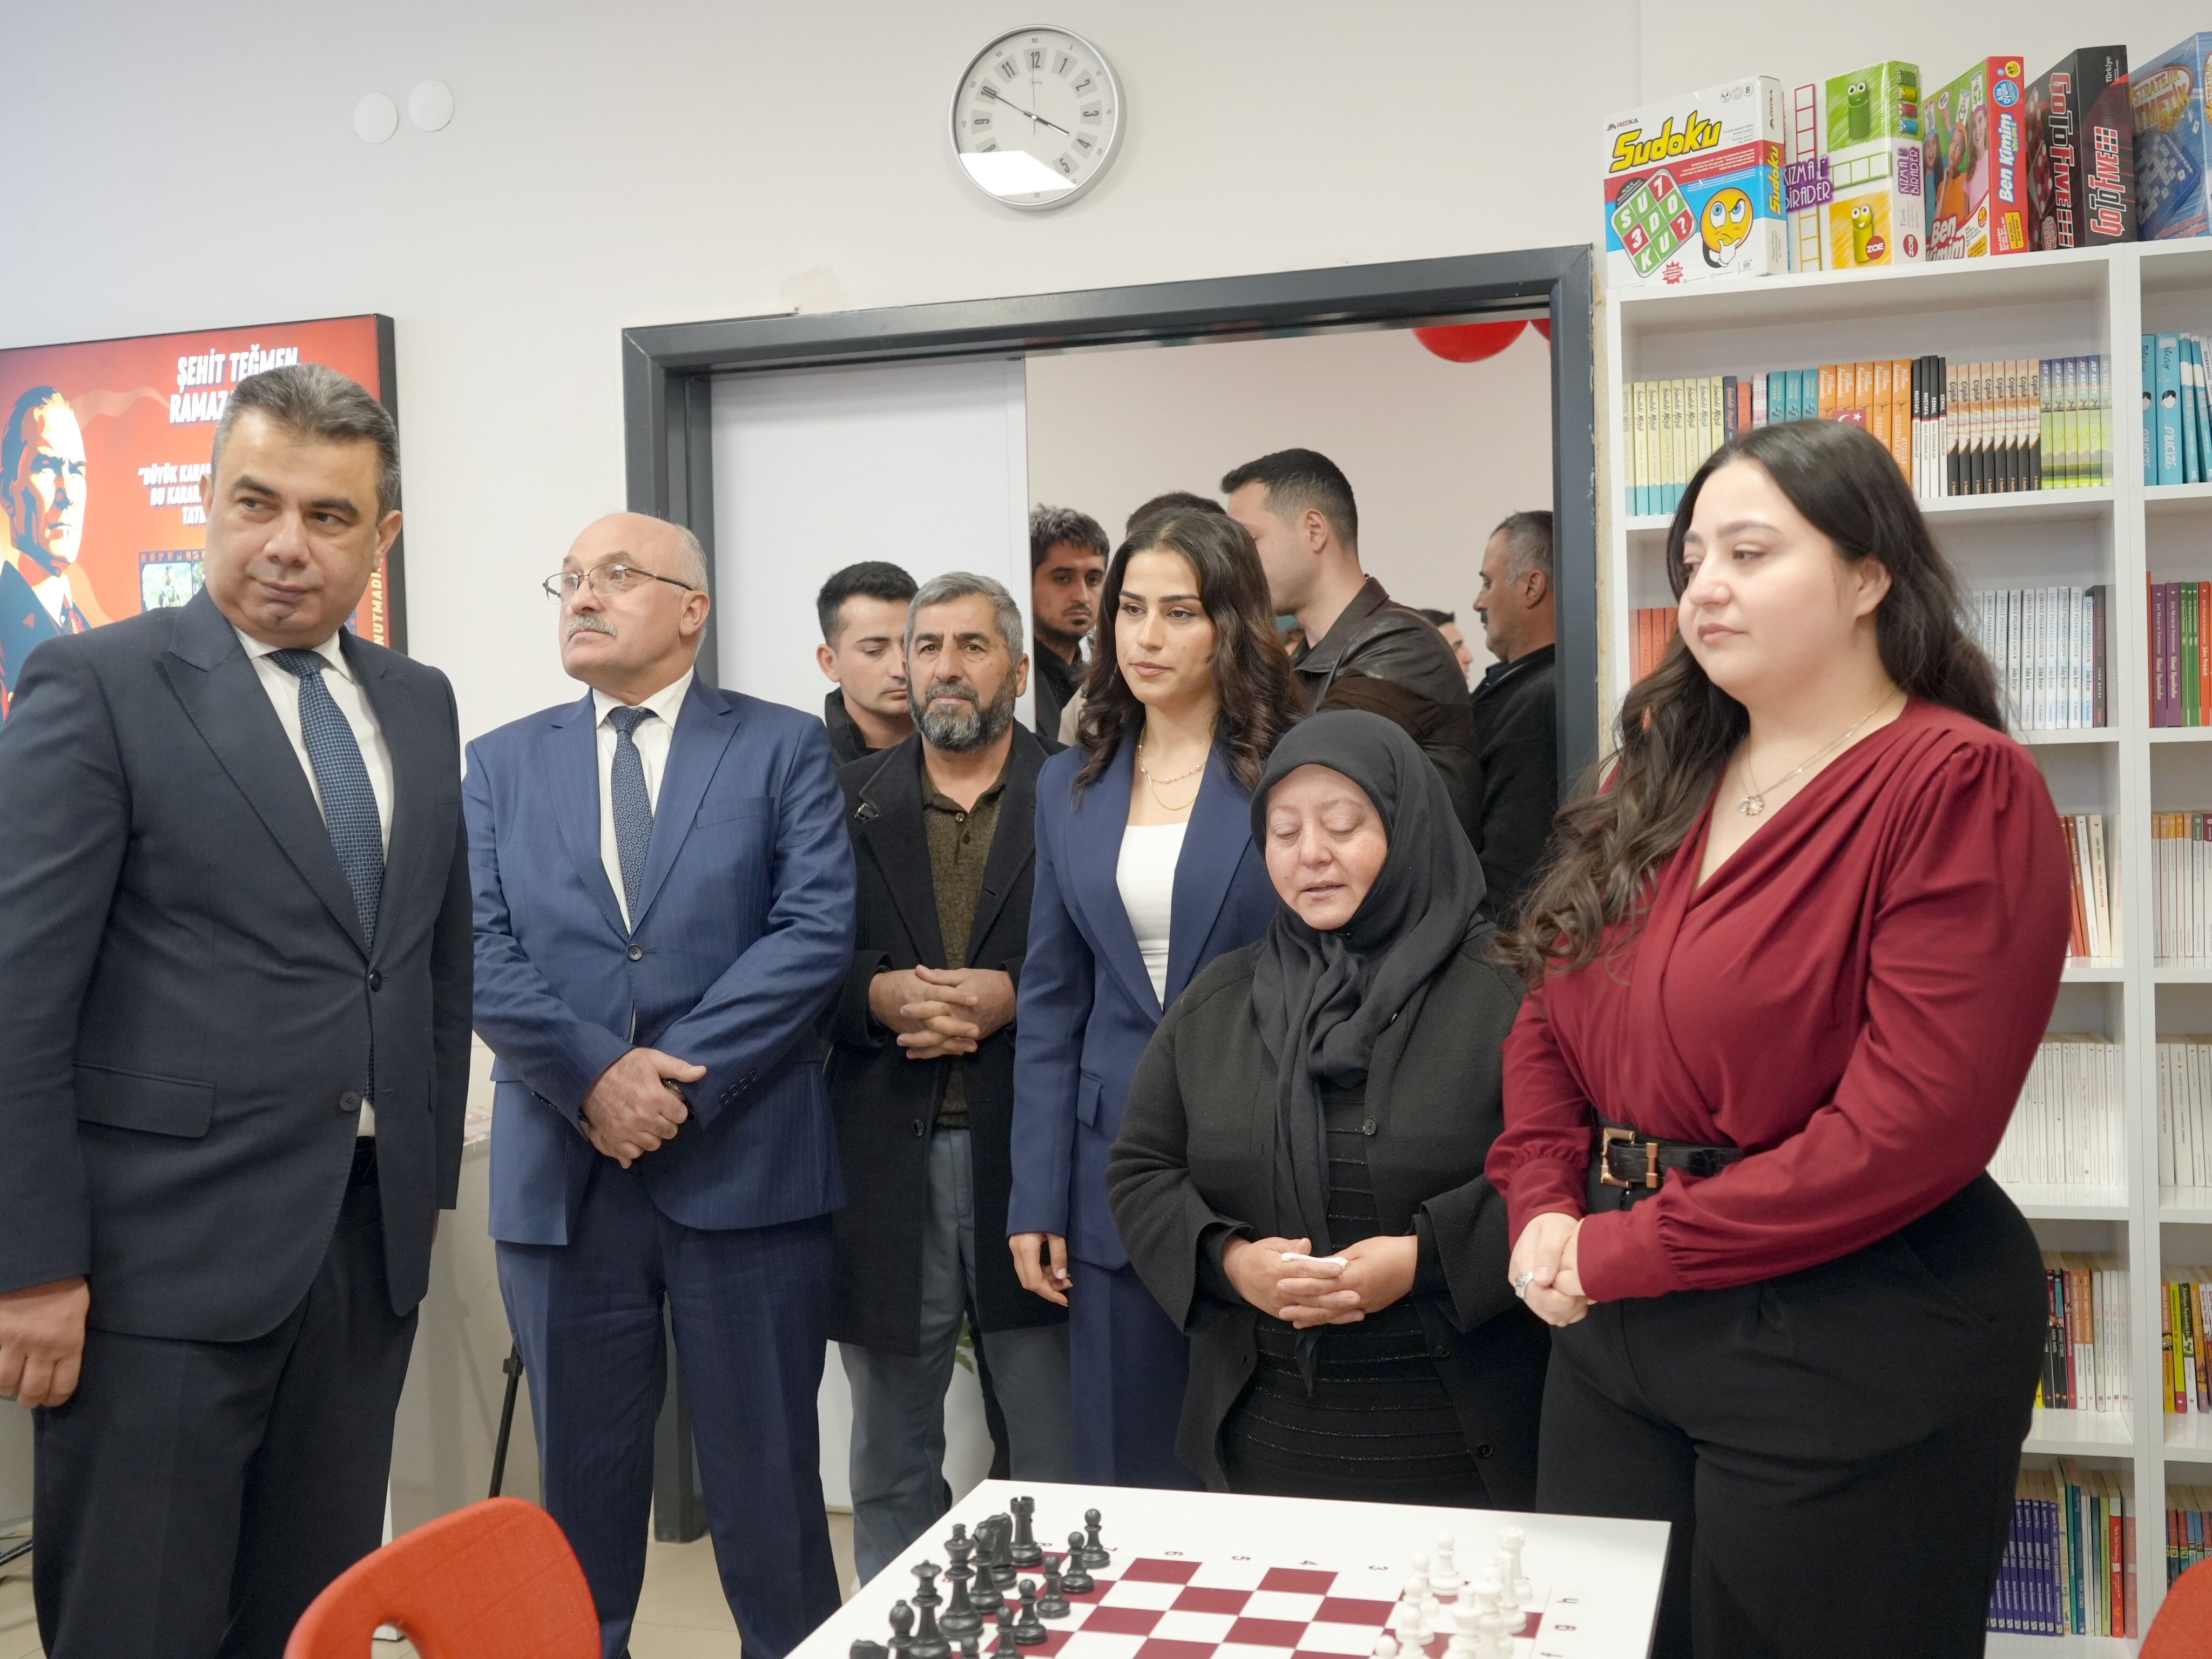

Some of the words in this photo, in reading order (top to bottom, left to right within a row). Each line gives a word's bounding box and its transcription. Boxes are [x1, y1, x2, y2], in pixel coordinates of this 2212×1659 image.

[1001, 60, 1015, 78] 11
[1030, 51, 1040, 69] 12
[1058, 57, 1068, 73] 1
[2007, 66, 2014, 75] 49
[2106, 56, 2114, 83] Türkiye
[980, 85, 997, 99] 10
[1075, 78, 1091, 92] 2
[1616, 118, 1638, 128] REDKA
[1076, 137, 1091, 149] 4
[1609, 110, 1722, 173] Sudoku
[1999, 113, 2013, 166] Kimim
[1059, 157, 1070, 173] 5
[1898, 160, 1908, 194] KIZMA
[1768, 145, 1781, 217] Sudoku
[1999, 167, 2015, 204] Ben
[1620, 208, 1631, 229] S
[1637, 191, 1649, 213] U
[1654, 176, 1663, 198] 1
[1631, 229, 1643, 249] 3
[1649, 212, 1660, 233] D
[1931, 215, 1957, 248] Ben
[1640, 247, 1653, 272] K
[1659, 231, 1670, 253] U
[1866, 242, 1885, 253] ZOE
[177, 348, 226, 393] ŞEHİT
[2162, 346, 2173, 370] alacio
[169, 390, 229, 423] RAMAZ
[150, 487, 165, 506] BU
[370, 558, 385, 646] NUTMADI
